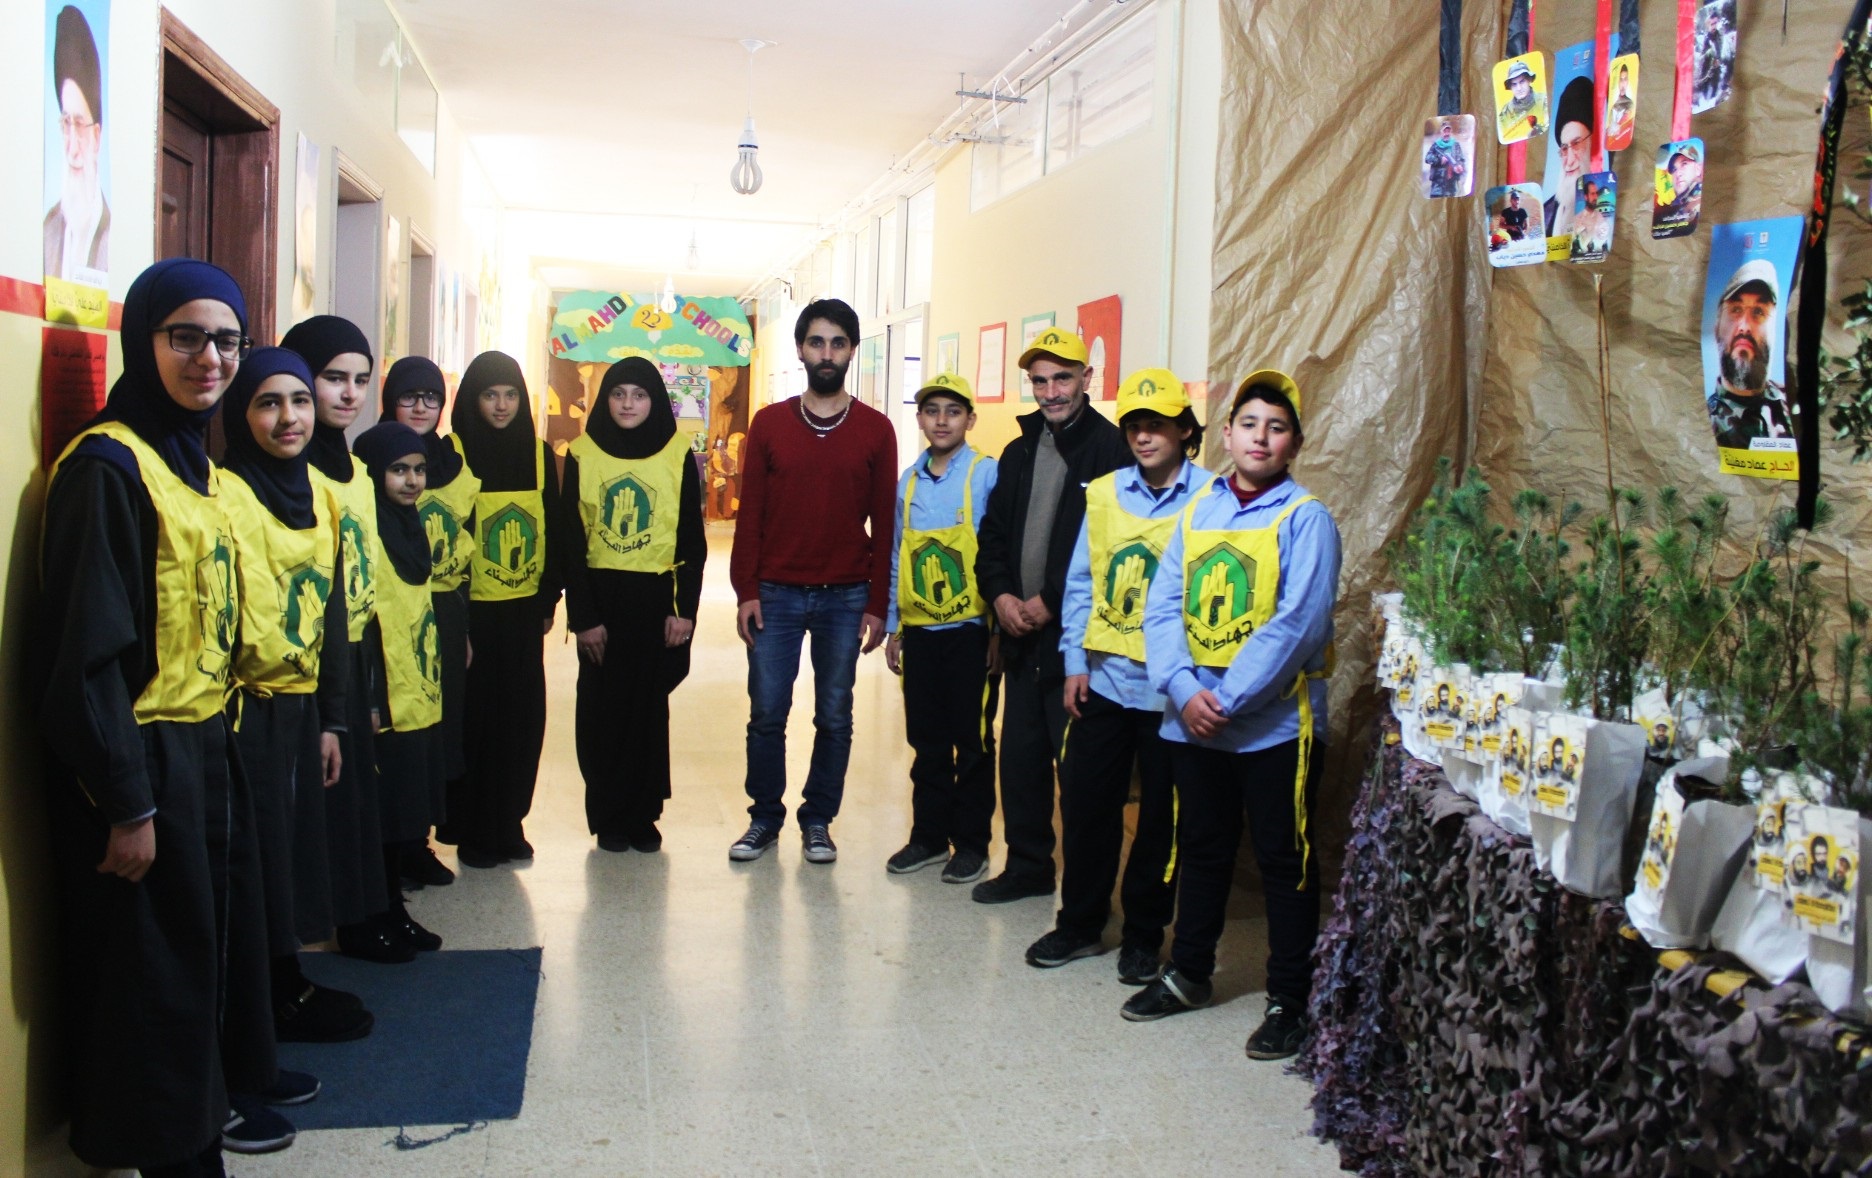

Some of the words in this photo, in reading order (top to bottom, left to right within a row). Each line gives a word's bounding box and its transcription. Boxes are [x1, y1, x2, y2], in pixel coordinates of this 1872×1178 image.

[551, 332, 579, 355] AL
[574, 291, 634, 344] MAHDI
[1747, 459, 1768, 471] عماد
[622, 533, 651, 554] جهاد
[514, 561, 537, 589] جهاد
[943, 595, 971, 622] جهاد
[1213, 620, 1254, 652] جهاد
